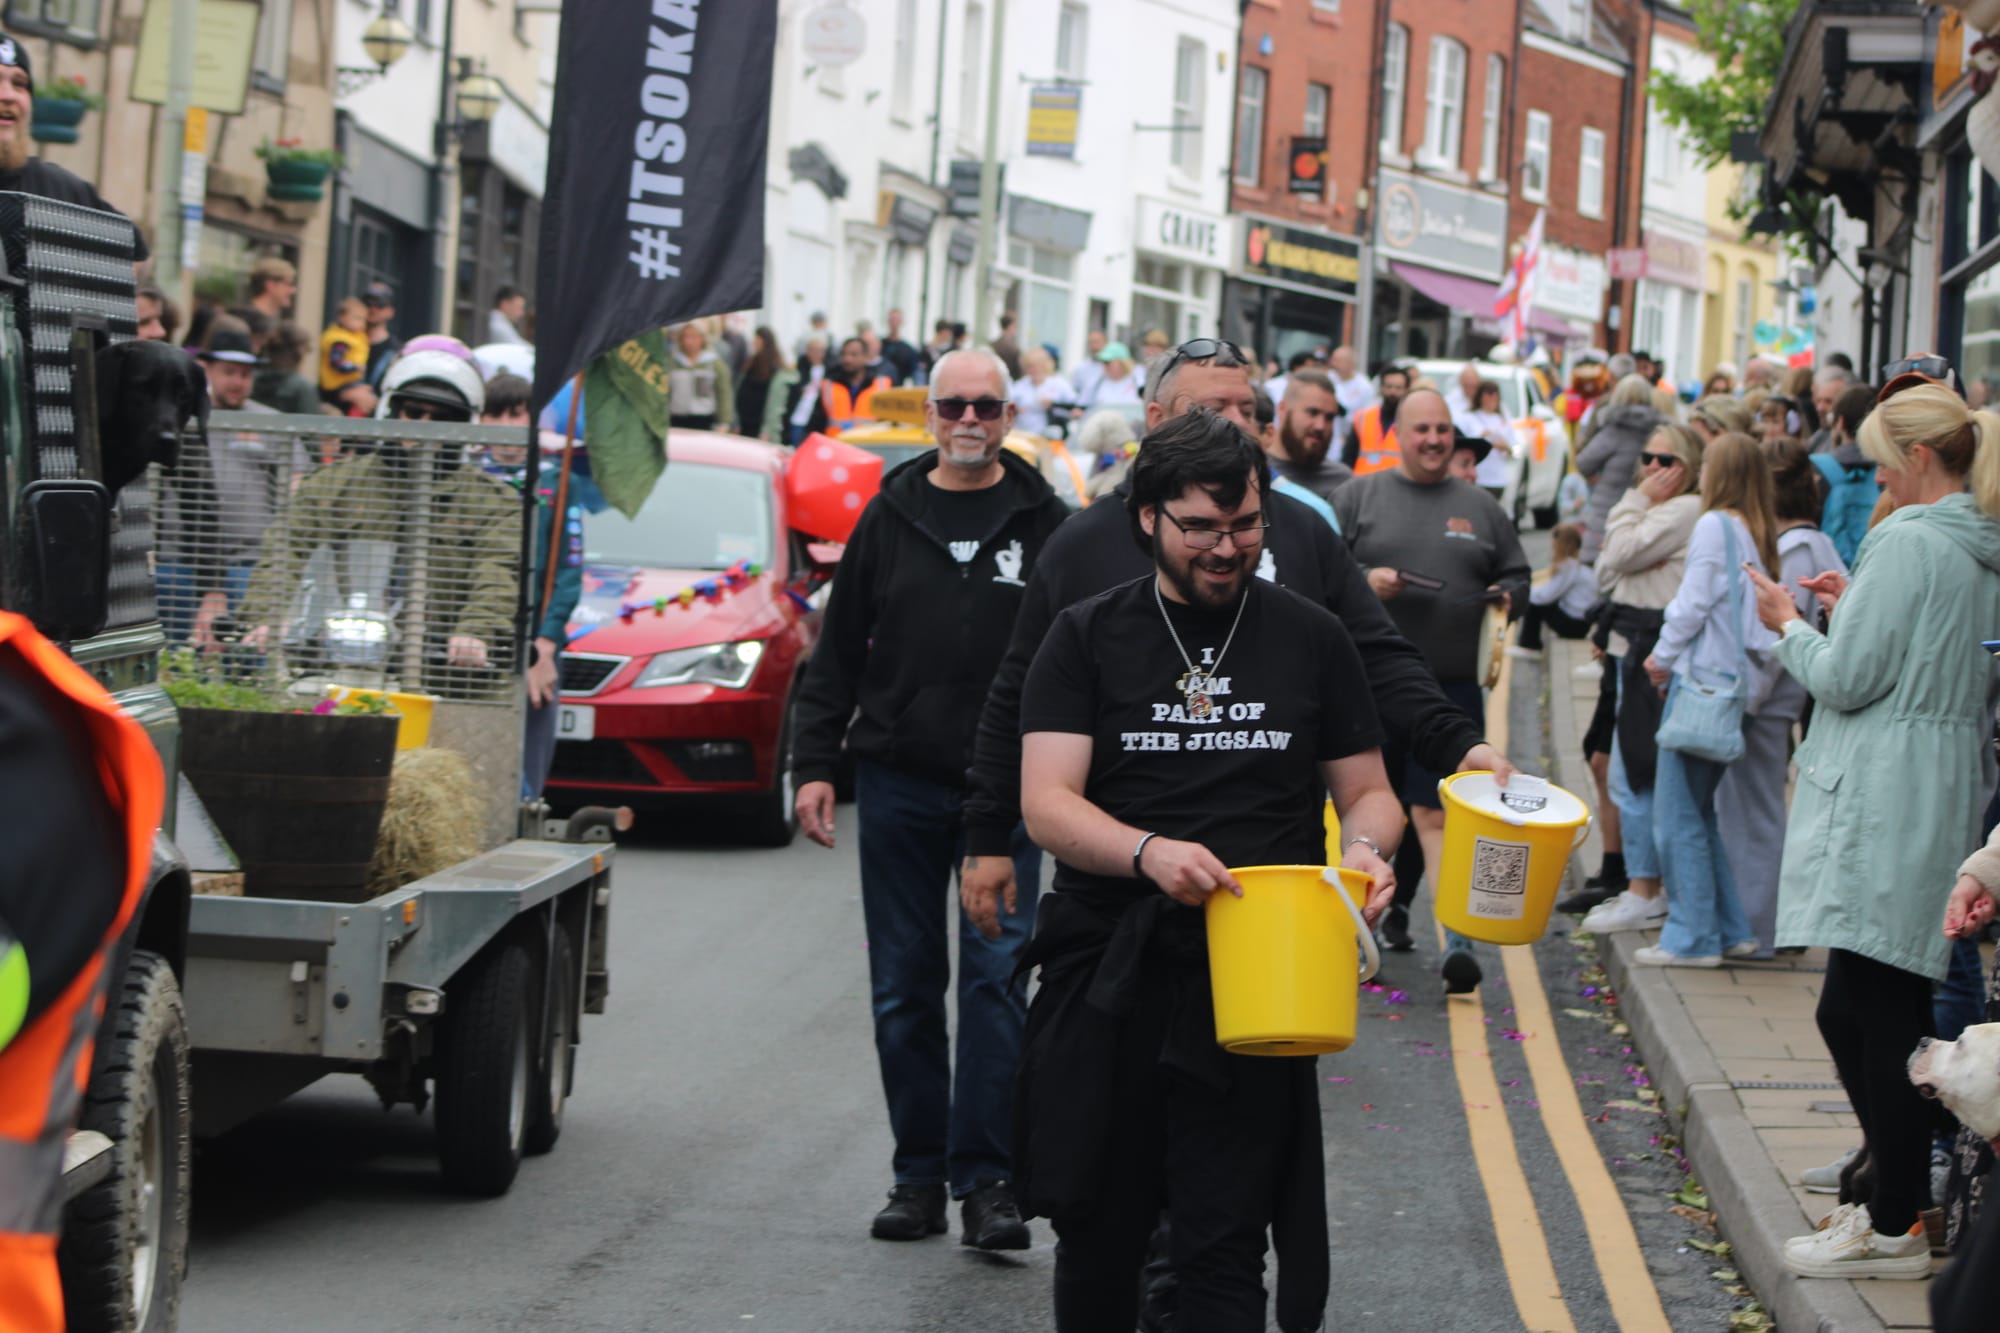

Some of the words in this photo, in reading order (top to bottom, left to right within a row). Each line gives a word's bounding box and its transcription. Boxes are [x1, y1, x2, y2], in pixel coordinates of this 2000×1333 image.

[1160, 209, 1216, 256] CRAVE
[618, 338, 669, 395] GILES
[1200, 647, 1215, 665] I
[1184, 676, 1232, 696] AM
[1229, 702, 1265, 721] OF
[1121, 732, 1180, 751] THE
[1185, 729, 1292, 751] JIGSAW
